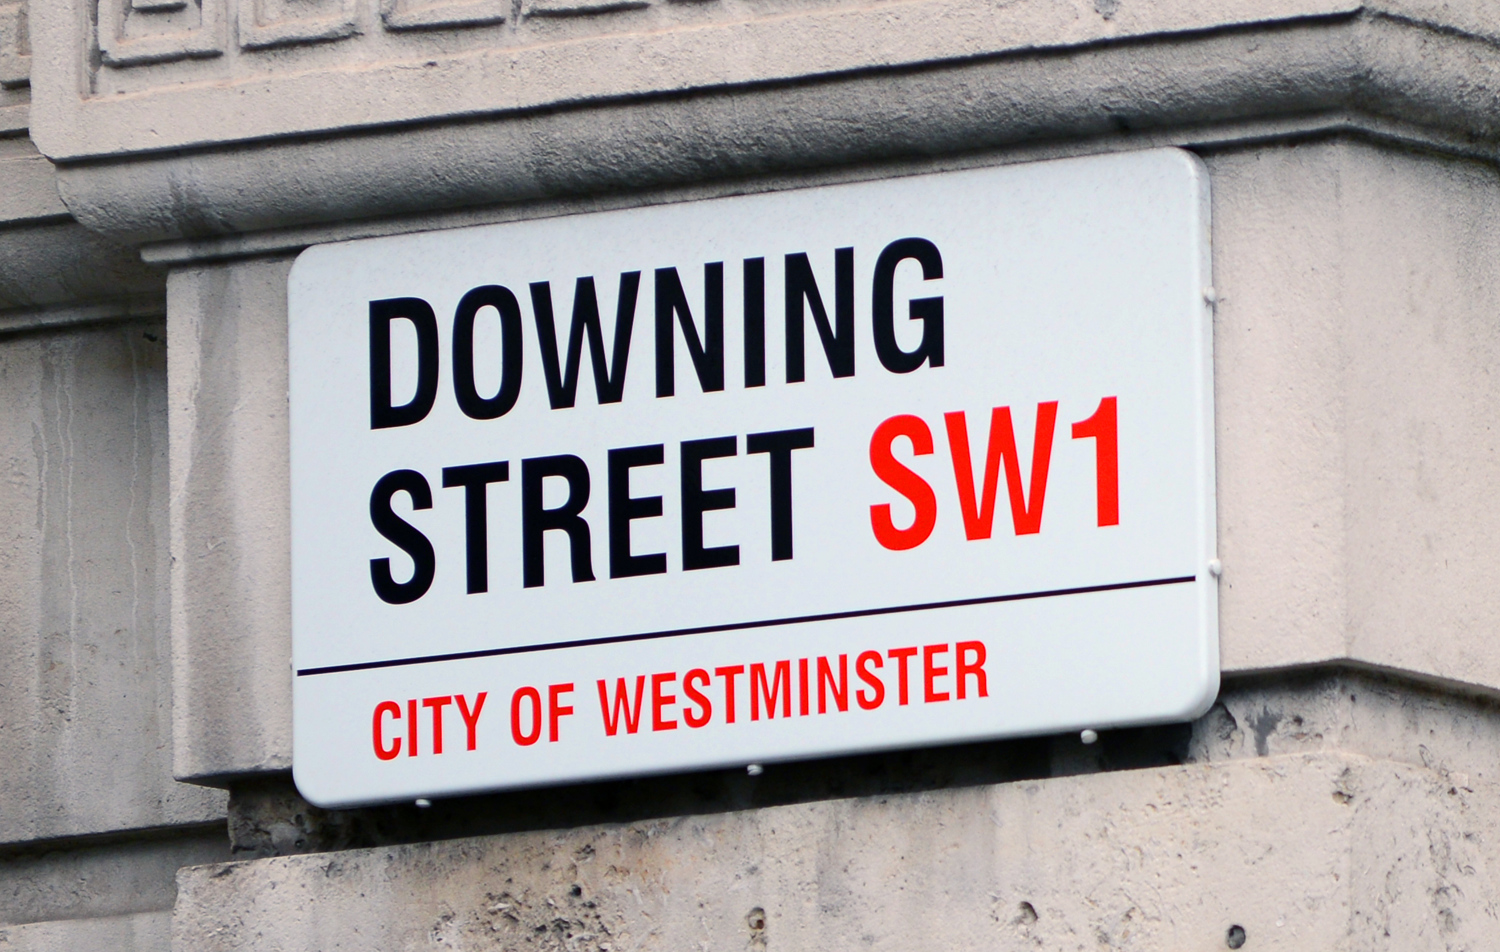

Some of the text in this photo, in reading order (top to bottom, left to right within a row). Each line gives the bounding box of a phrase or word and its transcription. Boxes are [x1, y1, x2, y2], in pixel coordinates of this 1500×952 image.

[369, 238, 944, 429] DOWNING
[369, 396, 1119, 604] STREET SW1
[373, 640, 989, 761] CITY OF WESTMINSTER
